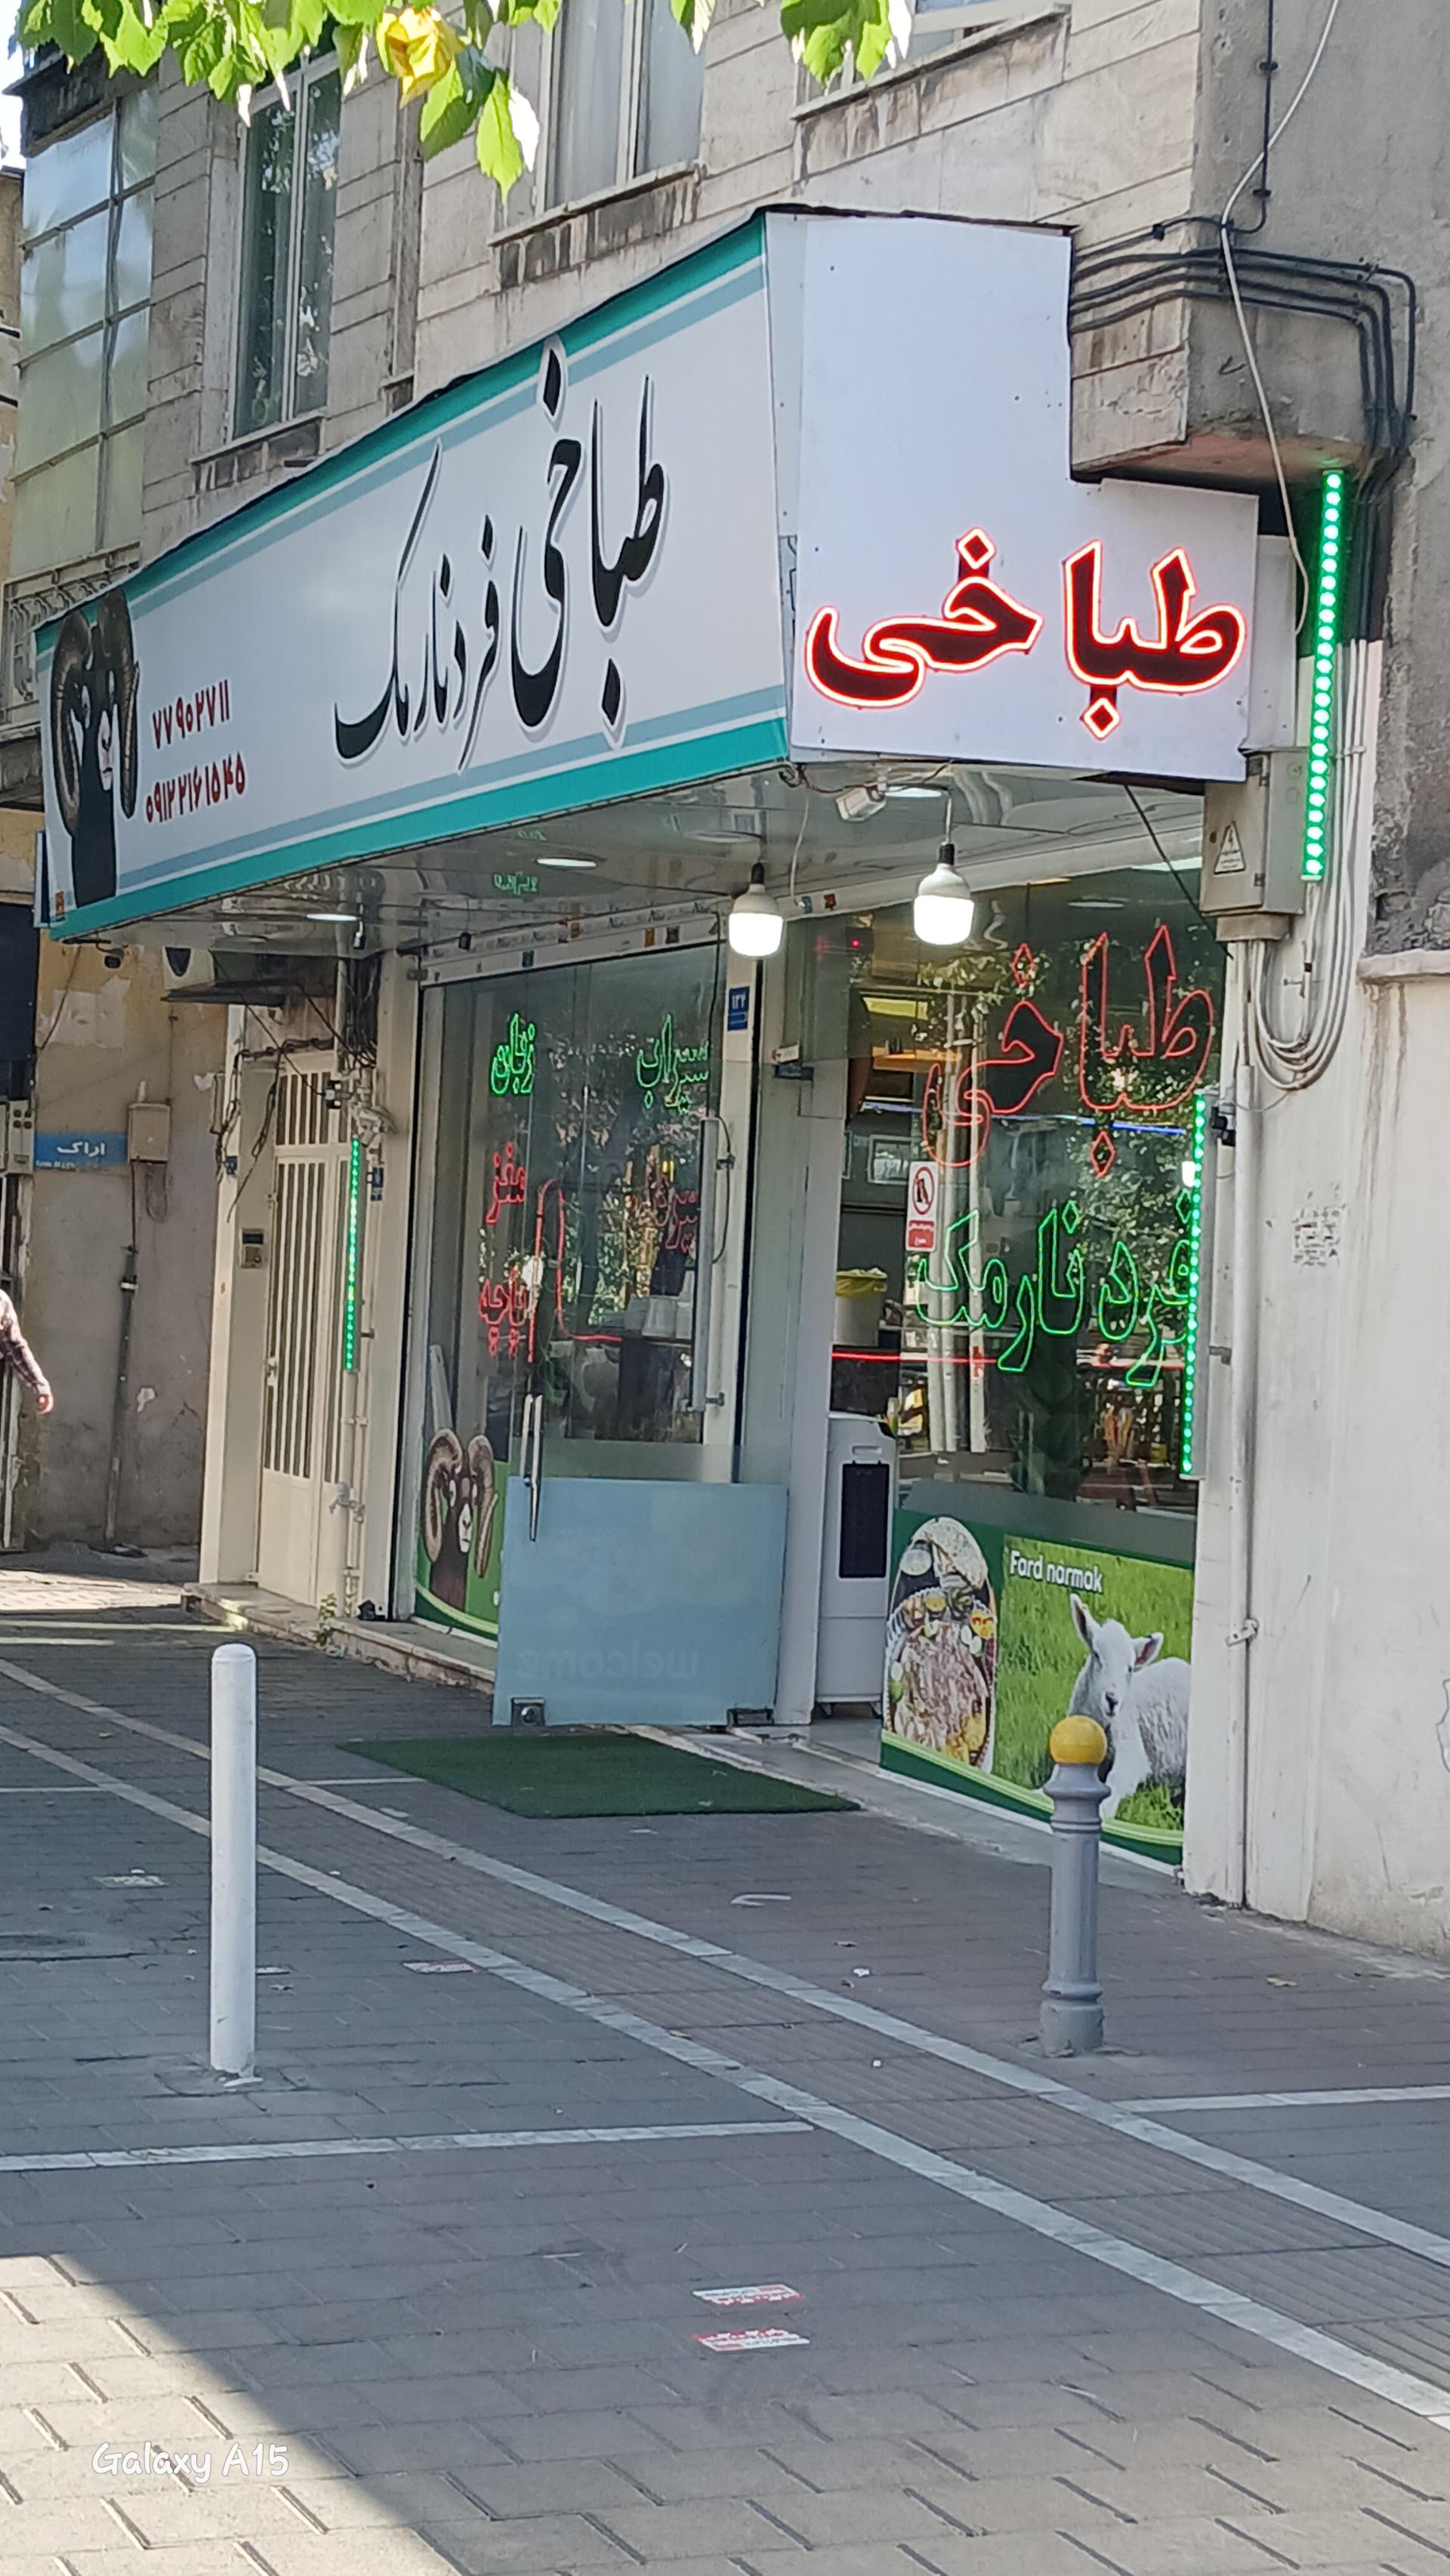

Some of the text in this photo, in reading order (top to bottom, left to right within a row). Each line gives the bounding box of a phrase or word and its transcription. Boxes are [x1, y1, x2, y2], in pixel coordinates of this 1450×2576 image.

[335, 348, 665, 772] طباخی فرد نارمک
[805, 528, 1246, 740] طباخی
[152, 679, 230, 747] ۷۷۹۰۲۷۱۱
[491, 1013, 535, 1095] زبان
[921, 924, 1215, 1179] طباخی
[57, 1141, 106, 1157] اراک
[486, 1141, 525, 1224] مغز
[478, 1264, 529, 1357] پاچه
[914, 1188, 1192, 1388] فرد نارمک
[1010, 1550, 1044, 1580] Fard
